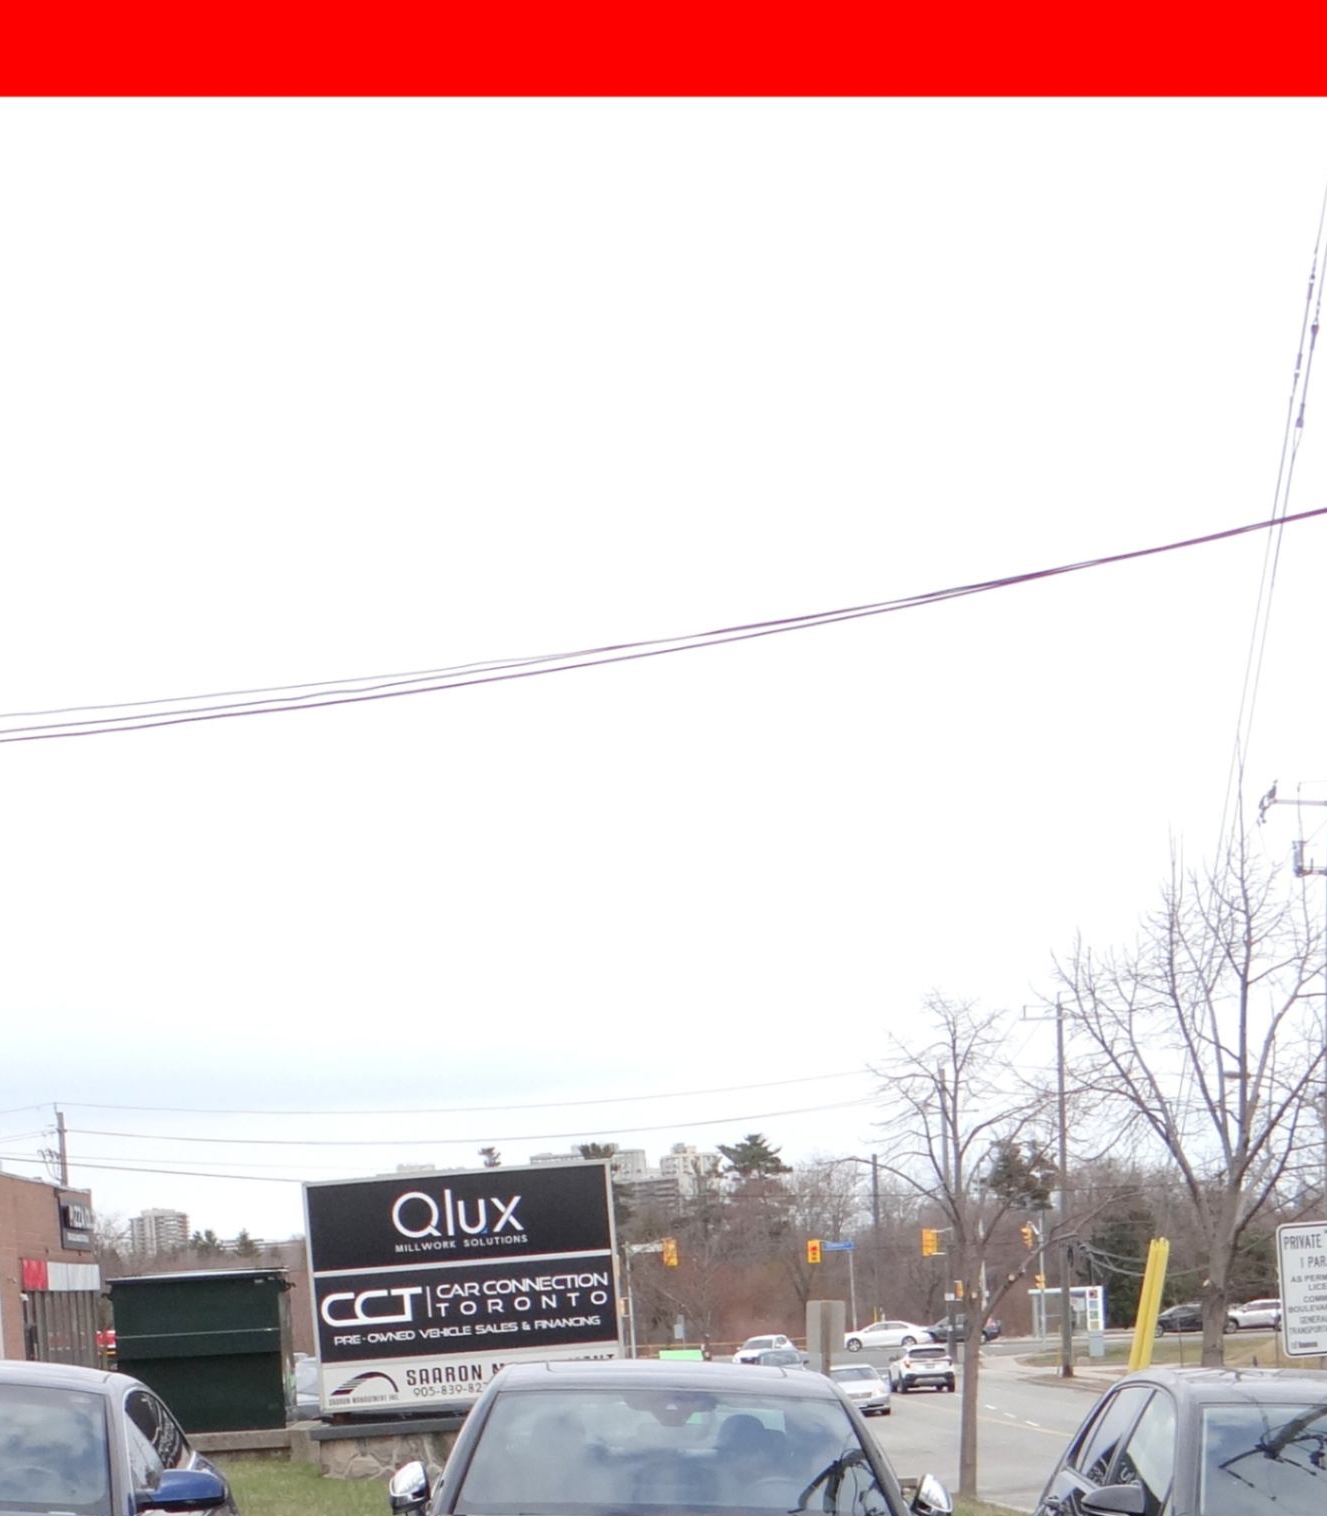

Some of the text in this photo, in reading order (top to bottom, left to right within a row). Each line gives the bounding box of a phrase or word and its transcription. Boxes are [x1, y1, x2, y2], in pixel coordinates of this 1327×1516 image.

[392, 1189, 524, 1238] Qlux
[395, 1234, 528, 1252] MILLWORK SOLUTIONS
[1283, 1233, 1322, 1250] PRIVATE
[1291, 1275, 1302, 1283] AS
[321, 1272, 608, 1327] CCT CAR CONNECTION
[436, 1291, 607, 1317] TORONTO
[334, 1315, 601, 1346] PRE-OWNED VEHICLE SALES & FINANCING
[406, 1364, 482, 1386] SAARON
[413, 1383, 488, 1397] 905-839-82
